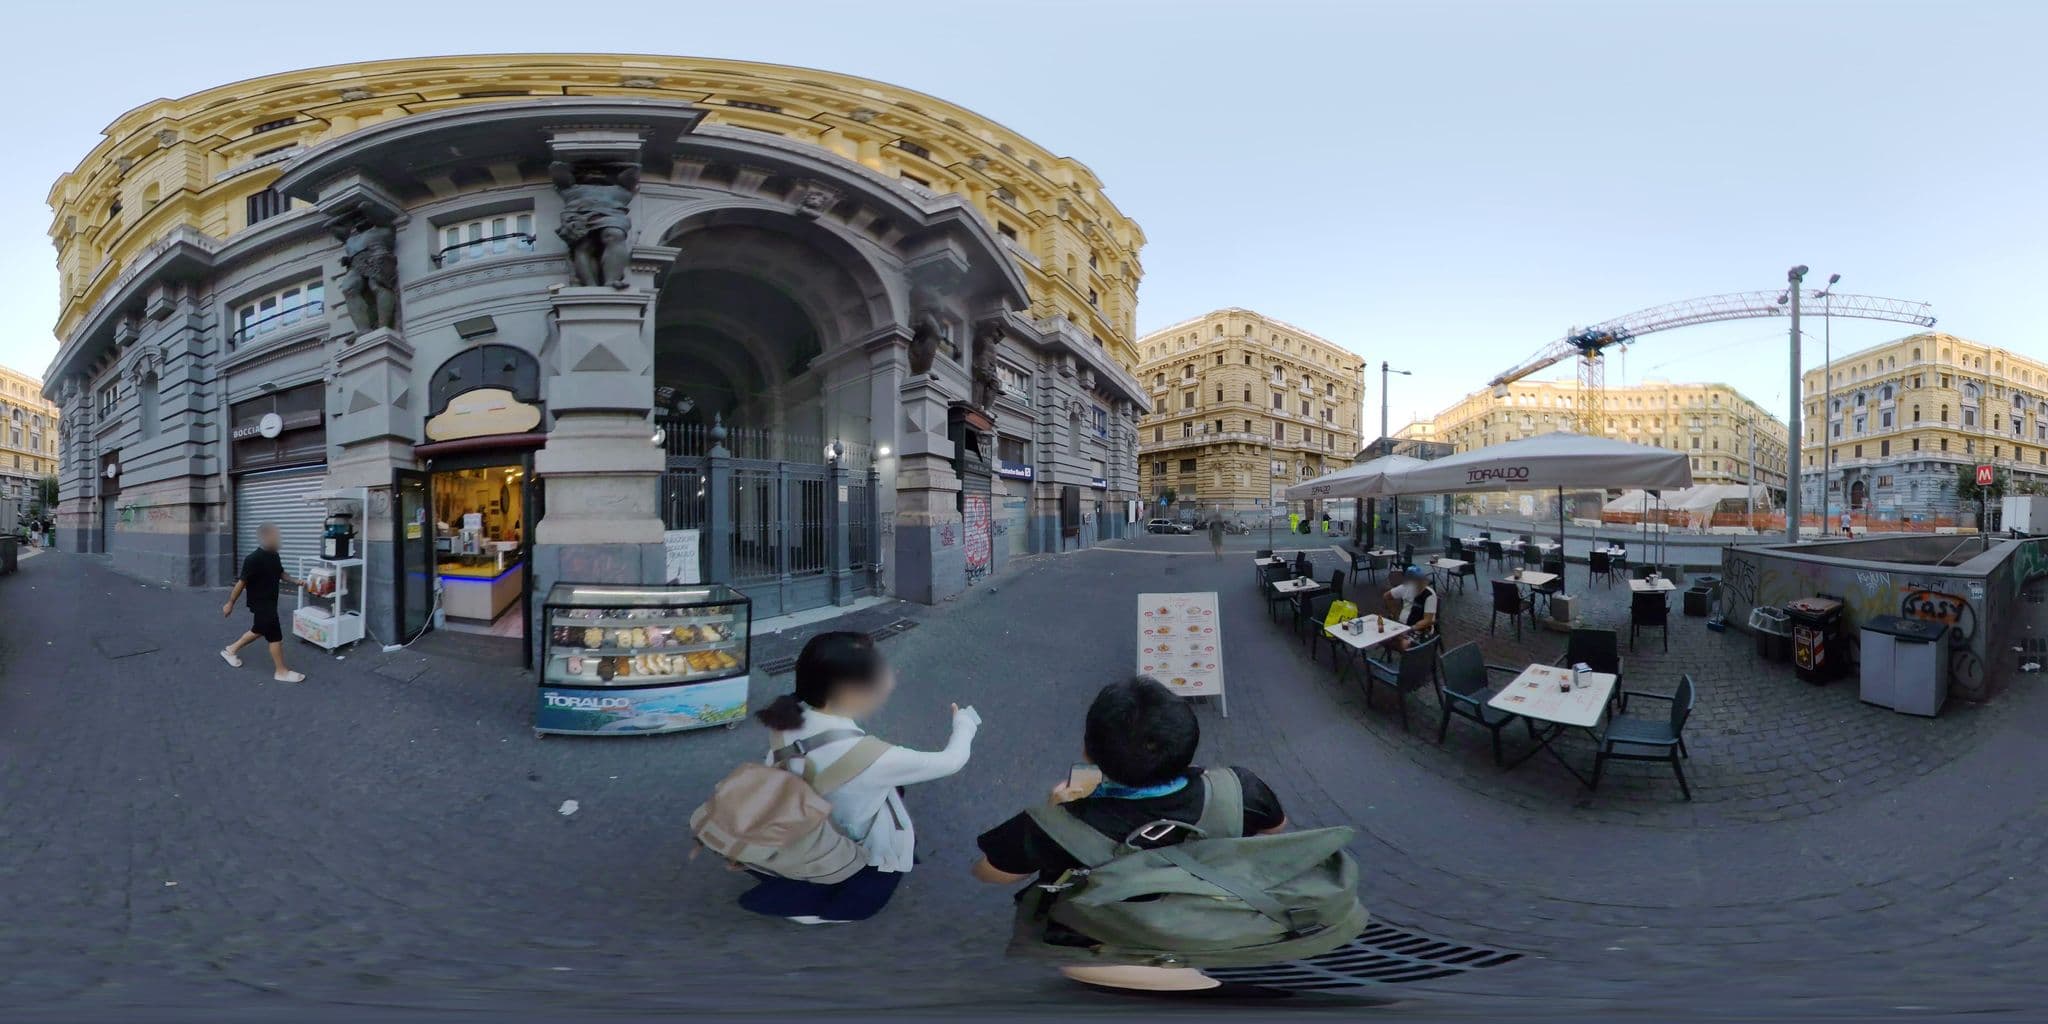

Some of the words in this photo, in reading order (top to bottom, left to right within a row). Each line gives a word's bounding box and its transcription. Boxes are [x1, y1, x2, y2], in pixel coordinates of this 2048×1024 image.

[1467, 467, 1529, 481] TORALDO
[1978, 468, 1991, 481] M
[544, 695, 630, 708] TORALDO
